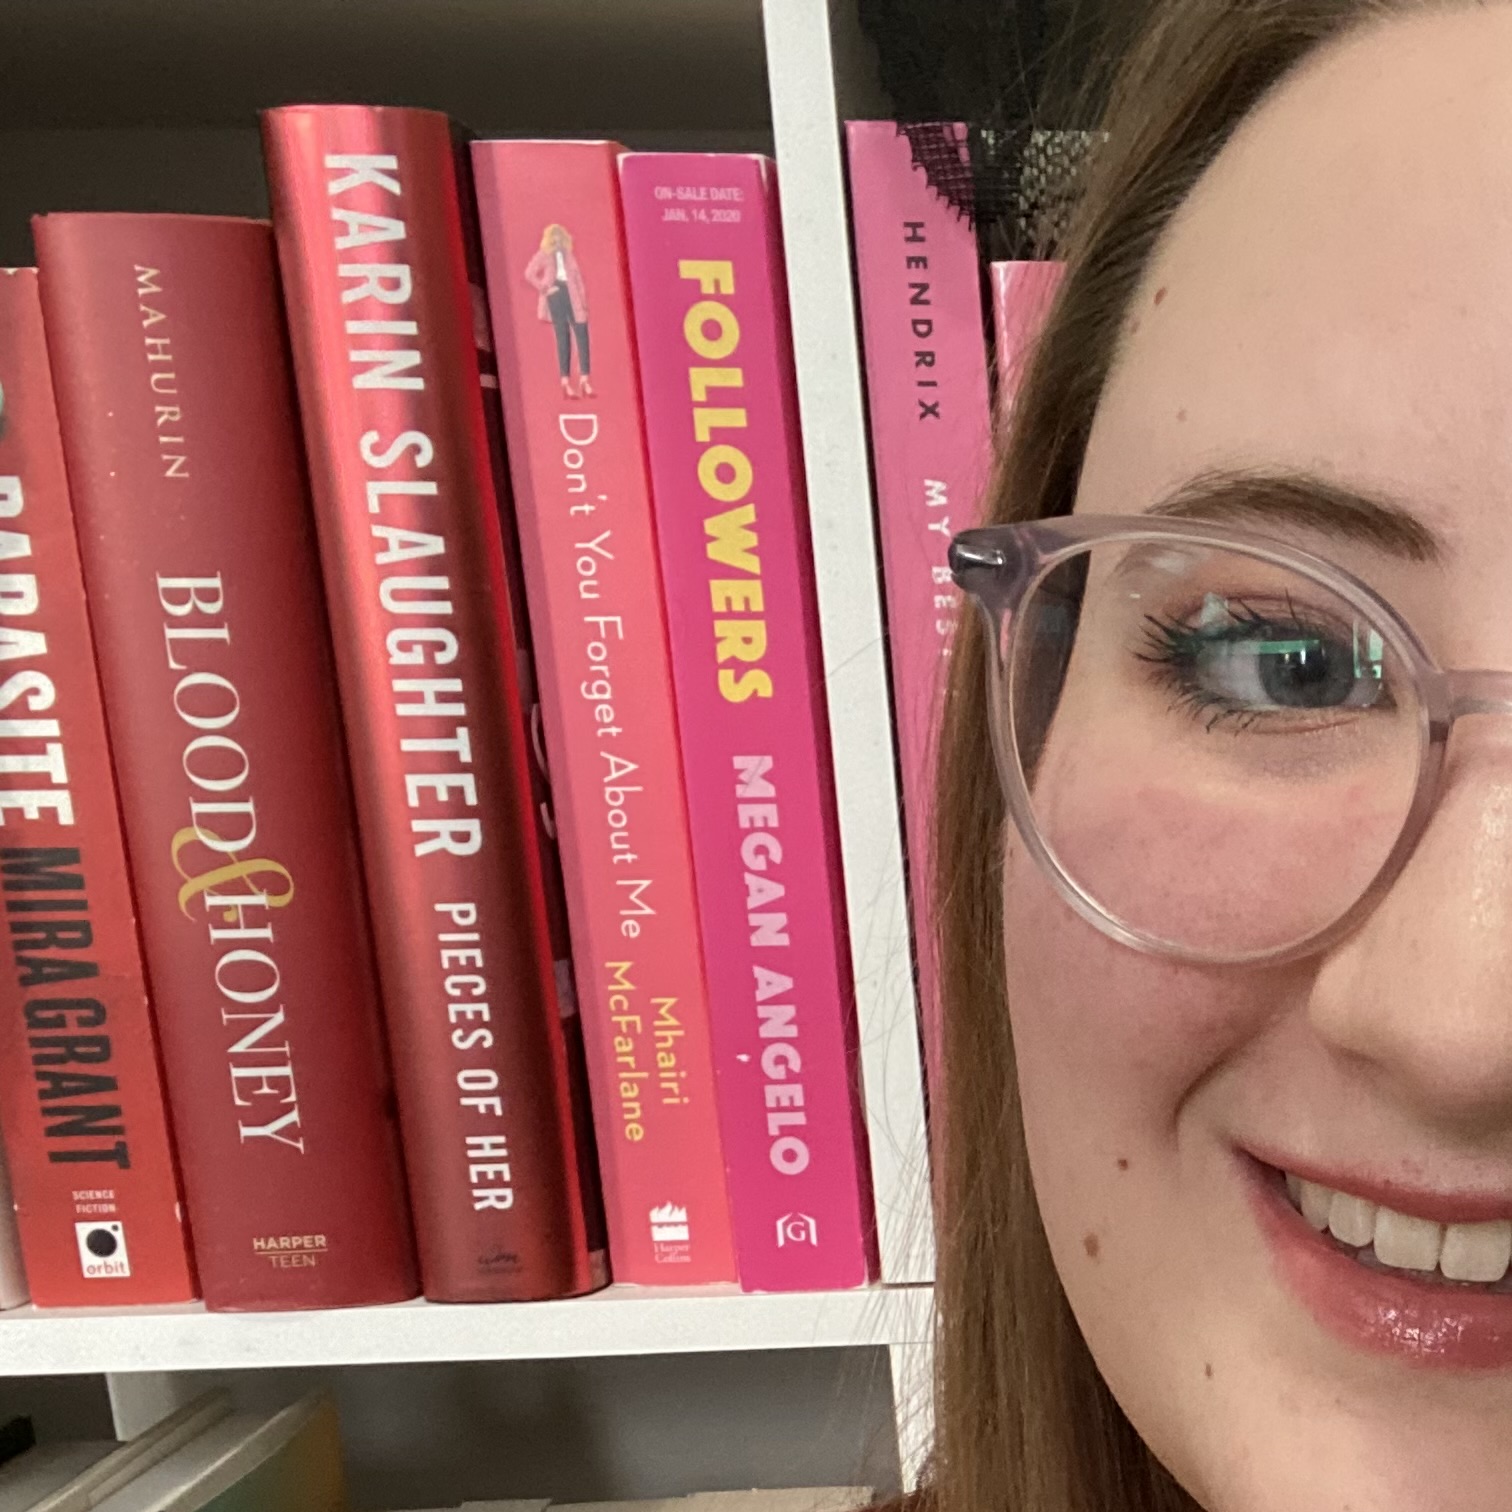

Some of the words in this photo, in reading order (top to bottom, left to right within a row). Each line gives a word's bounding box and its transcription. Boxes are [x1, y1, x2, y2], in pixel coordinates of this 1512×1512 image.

[654, 186, 708, 200] ON-SALE
[323, 154, 425, 391] KARIN
[903, 220, 941, 422] HENDRIX
[134, 264, 190, 480] MAHURIN
[559, 413, 608, 517] Don't
[678, 259, 774, 703] FOLLOWERS
[923, 478, 951, 537] MY
[574, 529, 615, 600] You
[931, 565, 959, 657] BES
[359, 430, 482, 858] SLAUGHTER
[580, 614, 624, 737] Forget
[155, 570, 257, 853] BLOOD
[600, 751, 643, 865] About
[732, 755, 790, 948] MEGAN
[1, 846, 99, 987] MIRA
[170, 825, 295, 923] &
[615, 879, 657, 939] Me
[203, 888, 305, 1155] HONEY
[434, 902, 494, 1051] PIECES
[22, 996, 131, 1169] GRANT
[456, 1068, 504, 1117] OF
[604, 959, 645, 1143] McFarlane
[650, 996, 689, 1106] Mhairi
[752, 965, 810, 1176] ANGELO
[72, 1189, 115, 1201] SCIENCE
[76, 1203, 117, 1214] FICTION
[464, 1134, 514, 1212] HER
[86, 1258, 127, 1276] orbit
[252, 1234, 327, 1251] HARPER
[268, 1254, 317, 1268] TEEN
[653, 1242, 690, 1255] Harper
[654, 1252, 692, 1264] Collins
[785, 1221, 807, 1242] G
